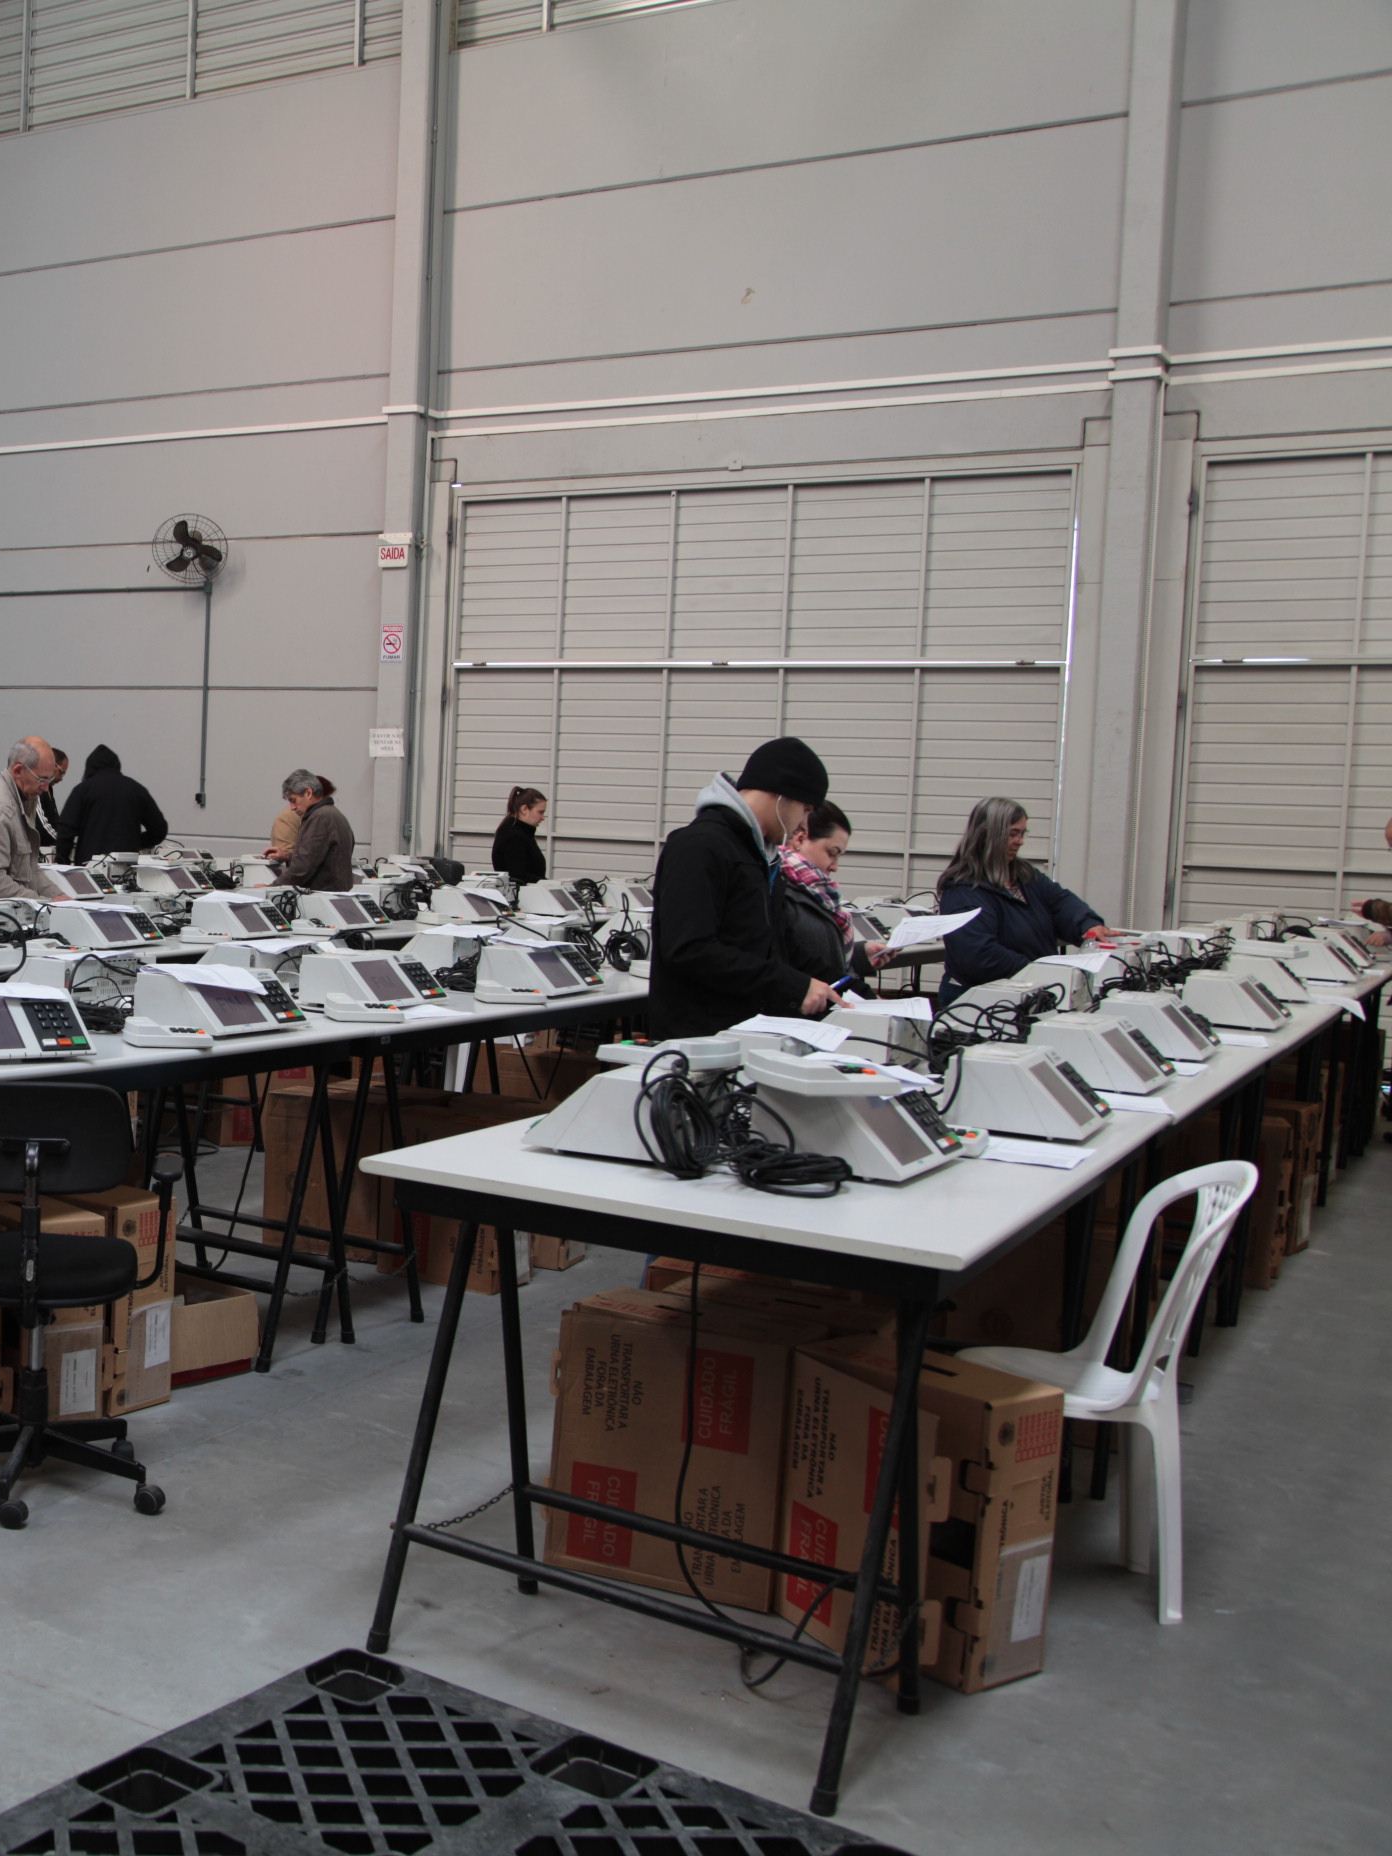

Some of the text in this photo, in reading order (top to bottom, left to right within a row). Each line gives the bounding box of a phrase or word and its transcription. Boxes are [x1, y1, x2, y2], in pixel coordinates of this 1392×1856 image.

[582, 1346, 596, 1415] EMBALAGEM
[595, 1360, 607, 1408] FORA DA
[604, 1334, 621, 1432] URNA ELETRÔNICA
[617, 1342, 633, 1429] TRANSPORTAR A
[631, 1380, 643, 1406] NÃO
[698, 1356, 717, 1440] CUIDADO
[719, 1370, 738, 1436] FRÁGIL
[813, 1376, 822, 1413] URNA
[792, 1388, 804, 1470] EMBALAGEM
[801, 1406, 811, 1461] FORA DA
[817, 1389, 830, 1485] TRANSPORTAR
[828, 1432, 837, 1461] NÃO
[583, 1480, 601, 1544] FRGIL
